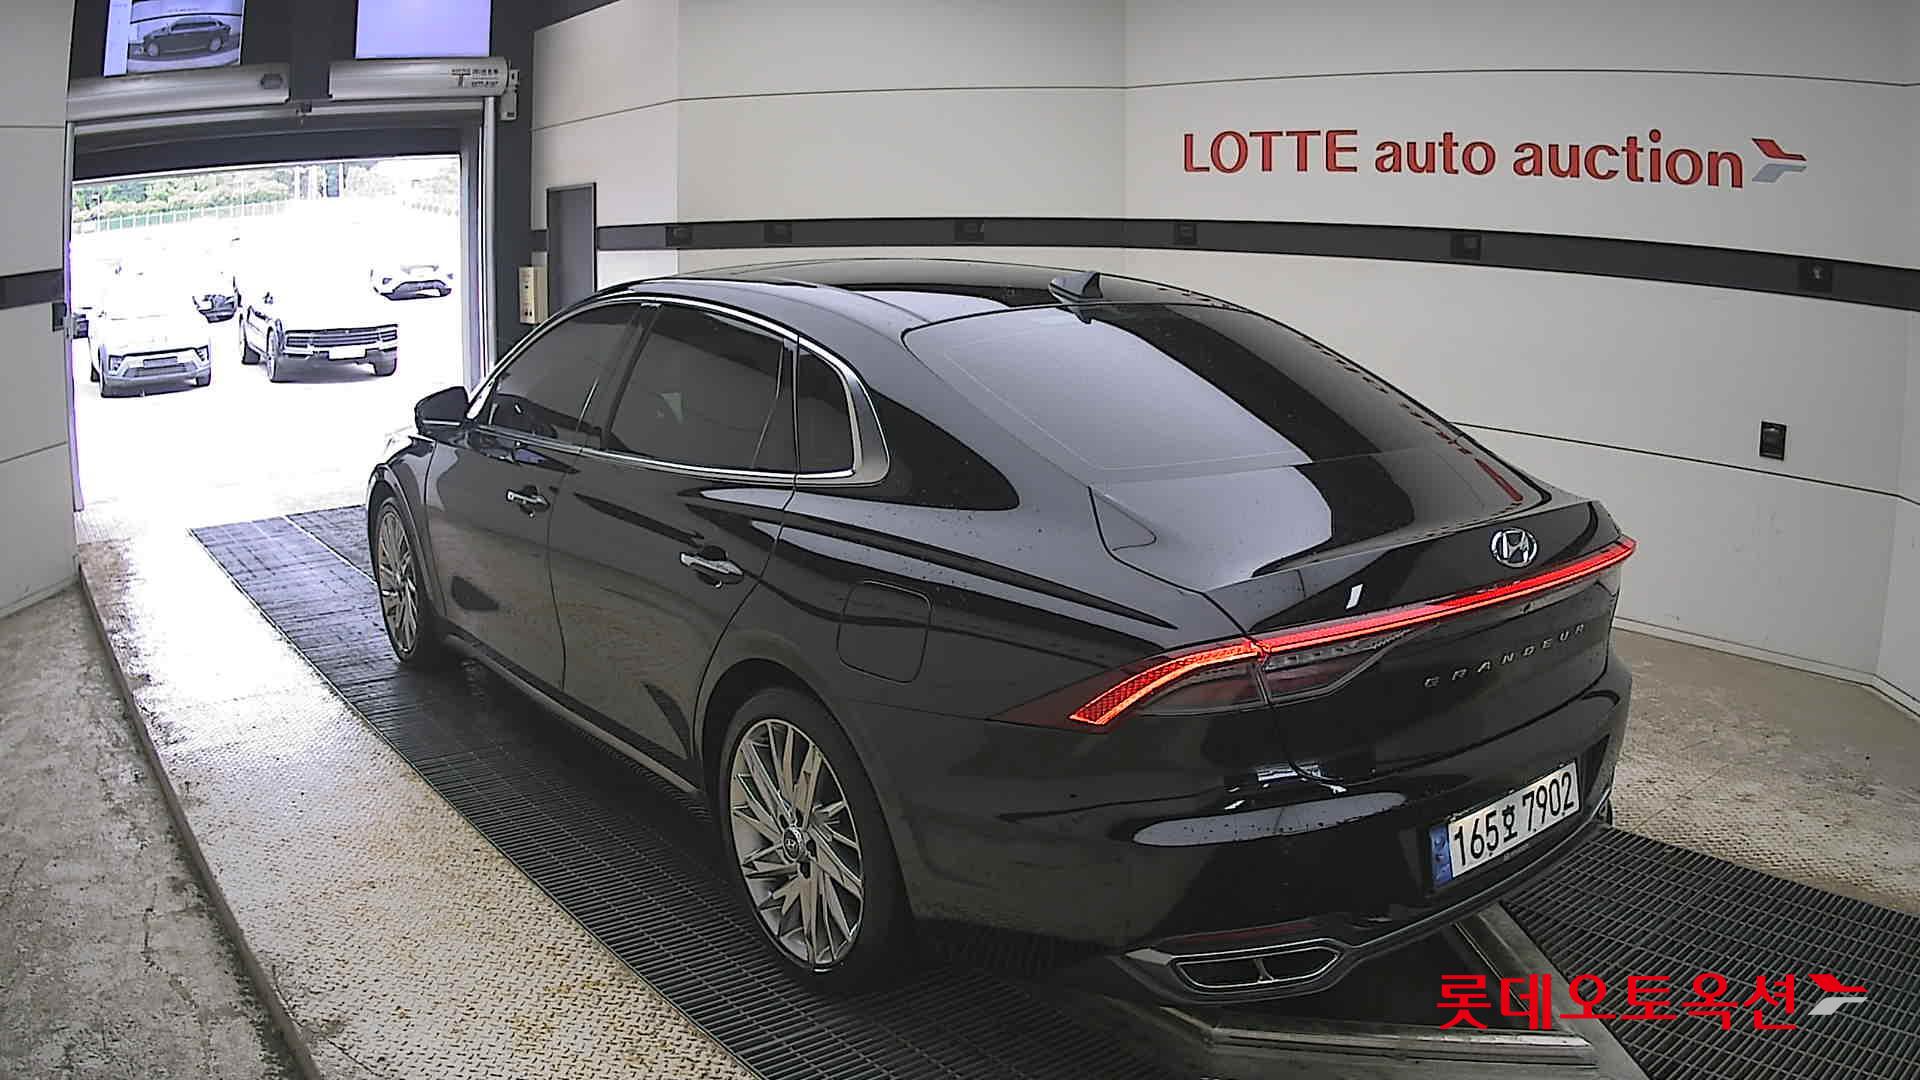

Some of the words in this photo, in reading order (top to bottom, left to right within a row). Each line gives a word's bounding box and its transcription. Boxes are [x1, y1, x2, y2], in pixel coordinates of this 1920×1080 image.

[1184, 130, 1358, 174] LOTTE
[1375, 131, 1496, 175] auto
[1513, 129, 1744, 188] auction
[1424, 623, 1585, 688] GRANDEUR
[1454, 804, 1518, 866] 165호
[1522, 771, 1574, 832] 7902
